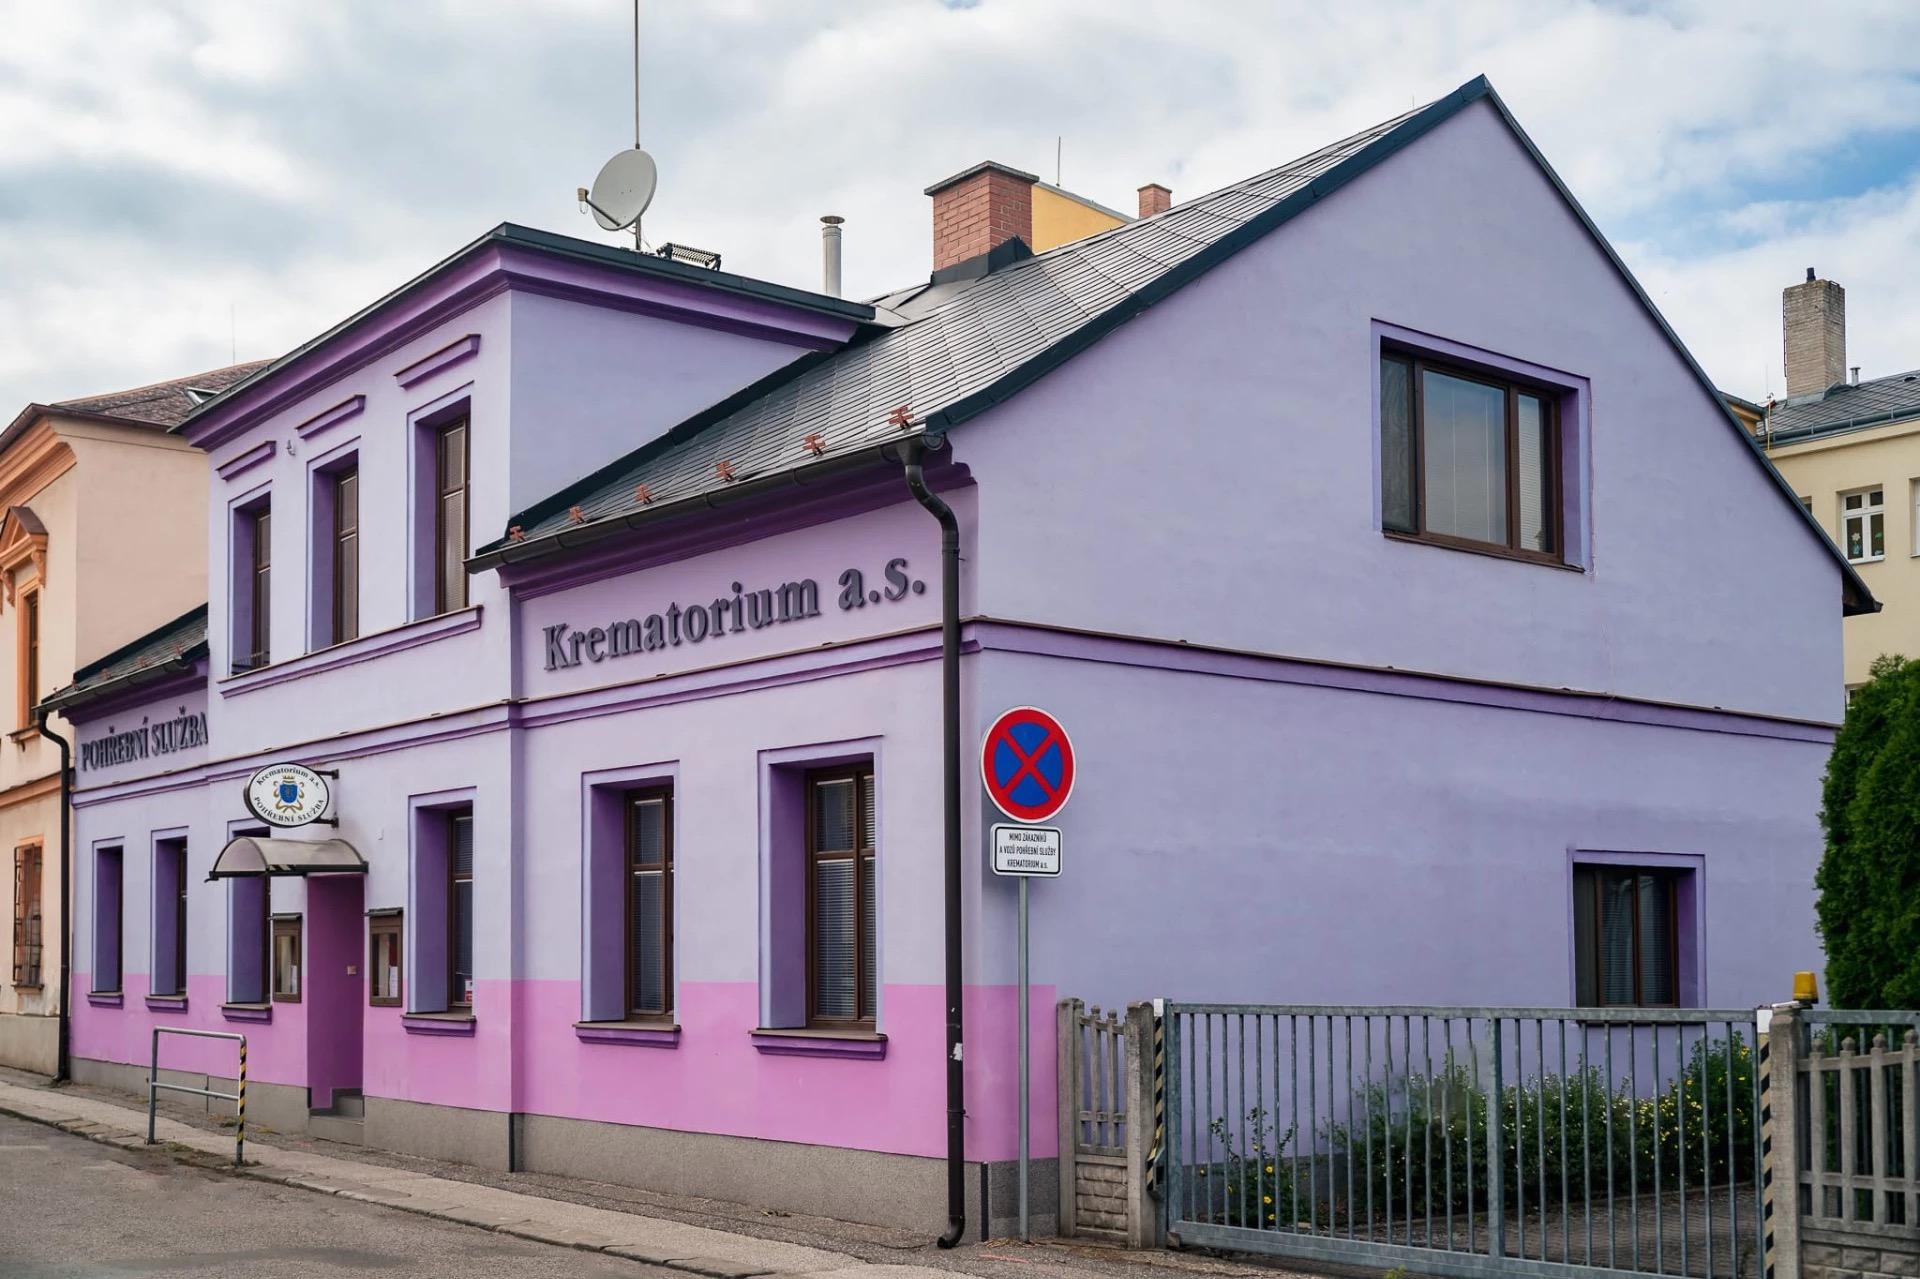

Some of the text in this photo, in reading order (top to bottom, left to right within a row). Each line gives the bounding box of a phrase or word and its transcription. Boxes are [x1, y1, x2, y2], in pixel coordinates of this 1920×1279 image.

[542, 557, 927, 671] Krematorium a.s.
[81, 705, 209, 772] POHŘEBNÍ SLUŽBA
[256, 767, 309, 786] Krematorium
[254, 796, 325, 822] POHŘEBNÍ SLUŽBA
[1009, 832, 1022, 842] MIMO
[1016, 844, 1039, 855] POHŘEBNÍ
[1040, 846, 1056, 856] SLUŽBY
[1007, 858, 1040, 868] KREMATORIUM
